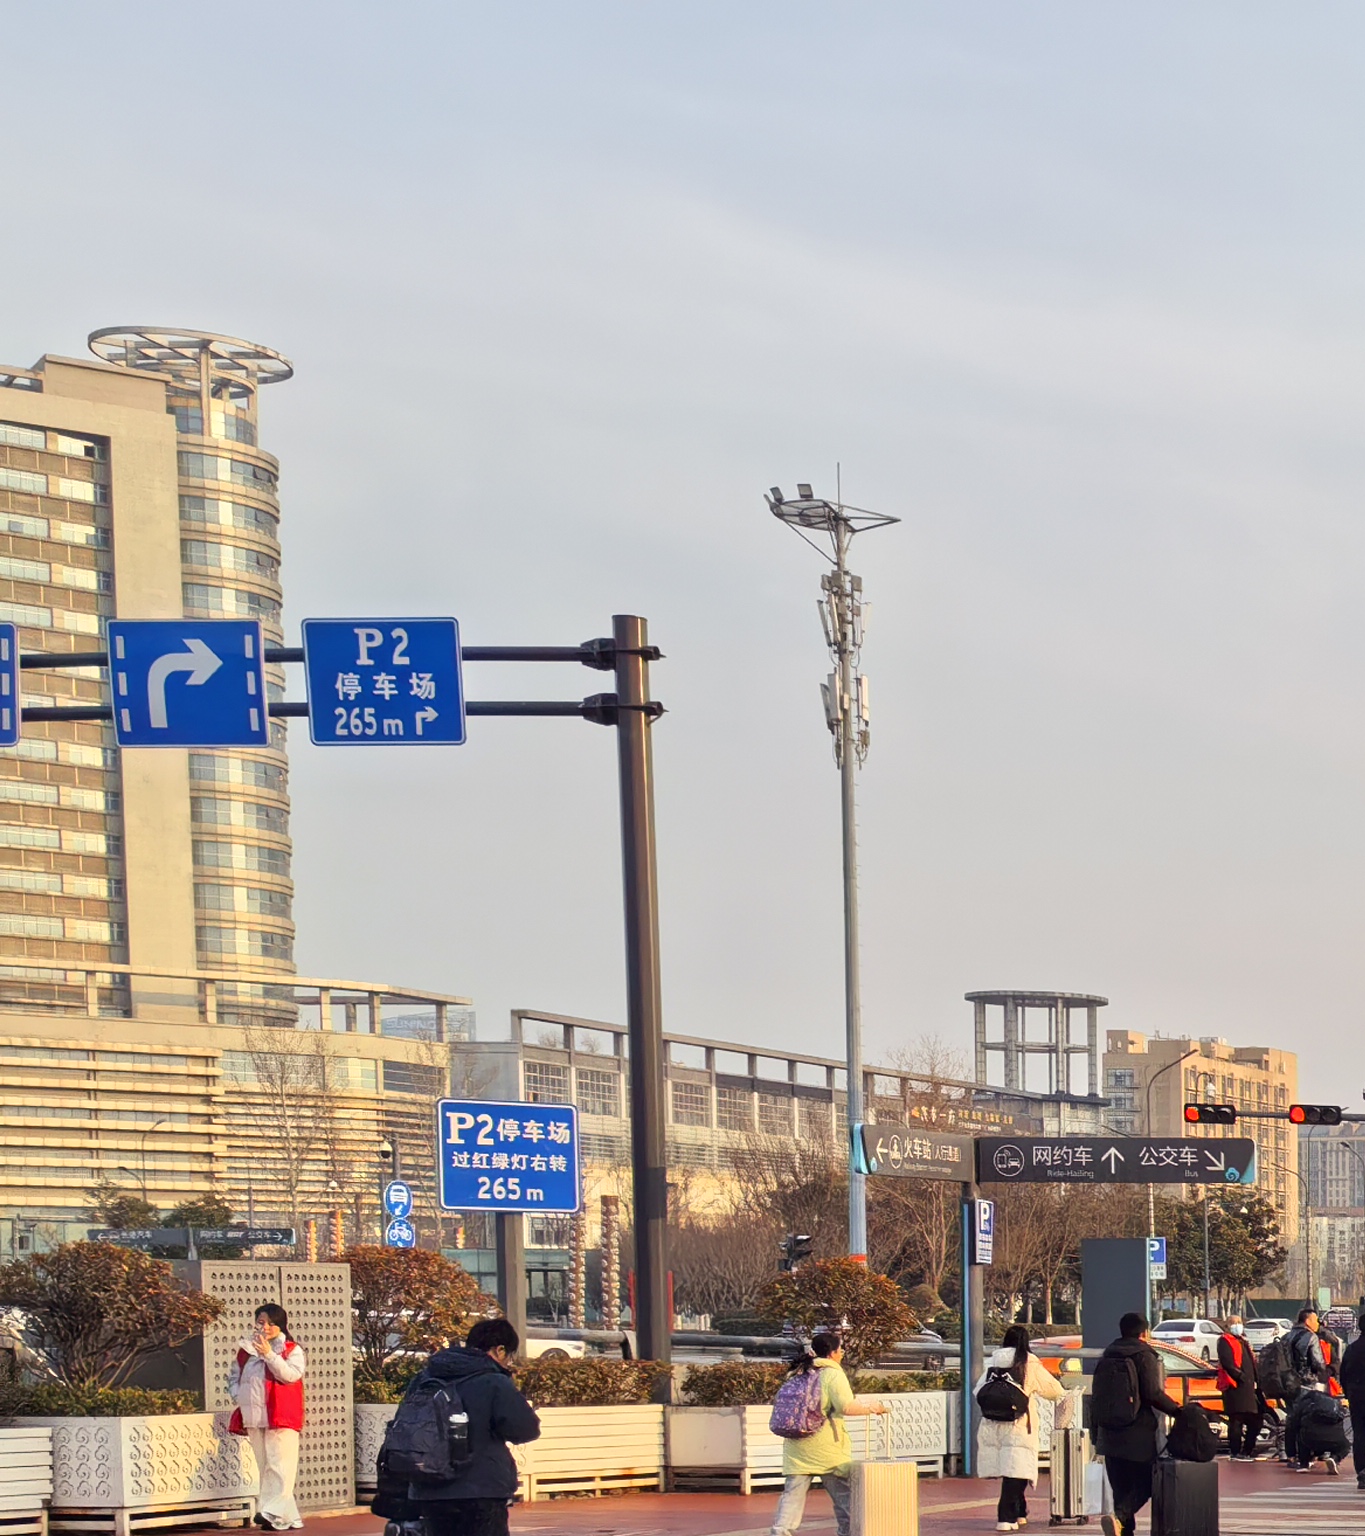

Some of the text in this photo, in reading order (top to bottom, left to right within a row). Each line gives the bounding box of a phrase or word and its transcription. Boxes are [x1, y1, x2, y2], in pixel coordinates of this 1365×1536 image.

[354, 627, 410, 666] P2
[335, 672, 436, 701] 停车场
[452, 1151, 568, 1172] 过红绿灯右转
[1032, 1146, 1199, 1167] 网约车 公交车
